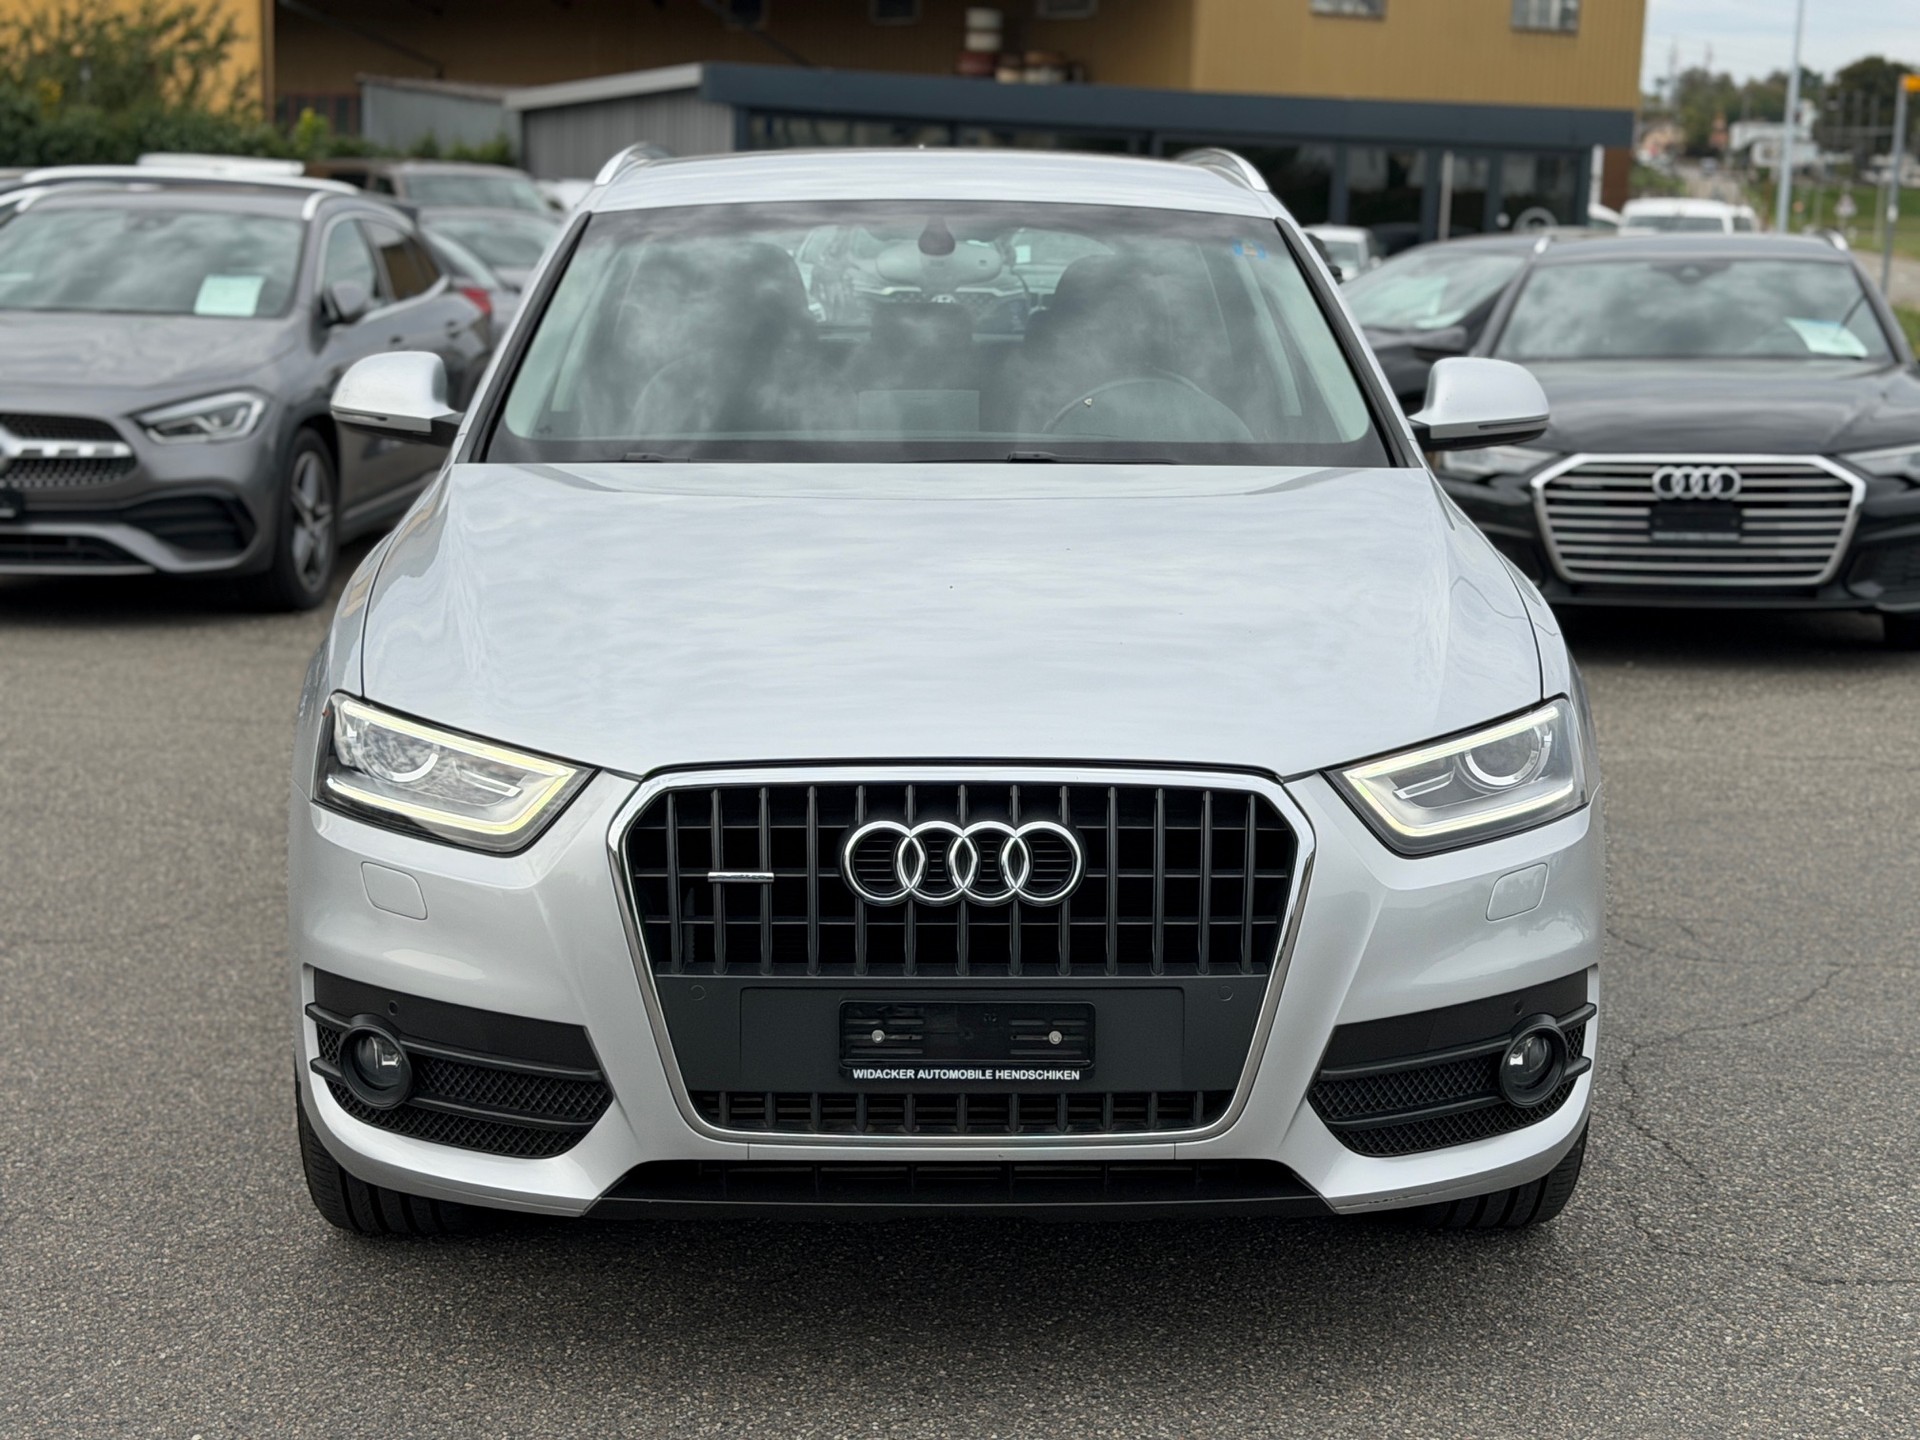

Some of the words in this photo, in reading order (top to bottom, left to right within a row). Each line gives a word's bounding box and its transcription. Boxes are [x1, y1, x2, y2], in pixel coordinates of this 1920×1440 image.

[853, 1069, 915, 1079] WIDACKER
[917, 1069, 993, 1080] AUTOMOBILE
[996, 1069, 1080, 1080] HENDSCHIKEN
